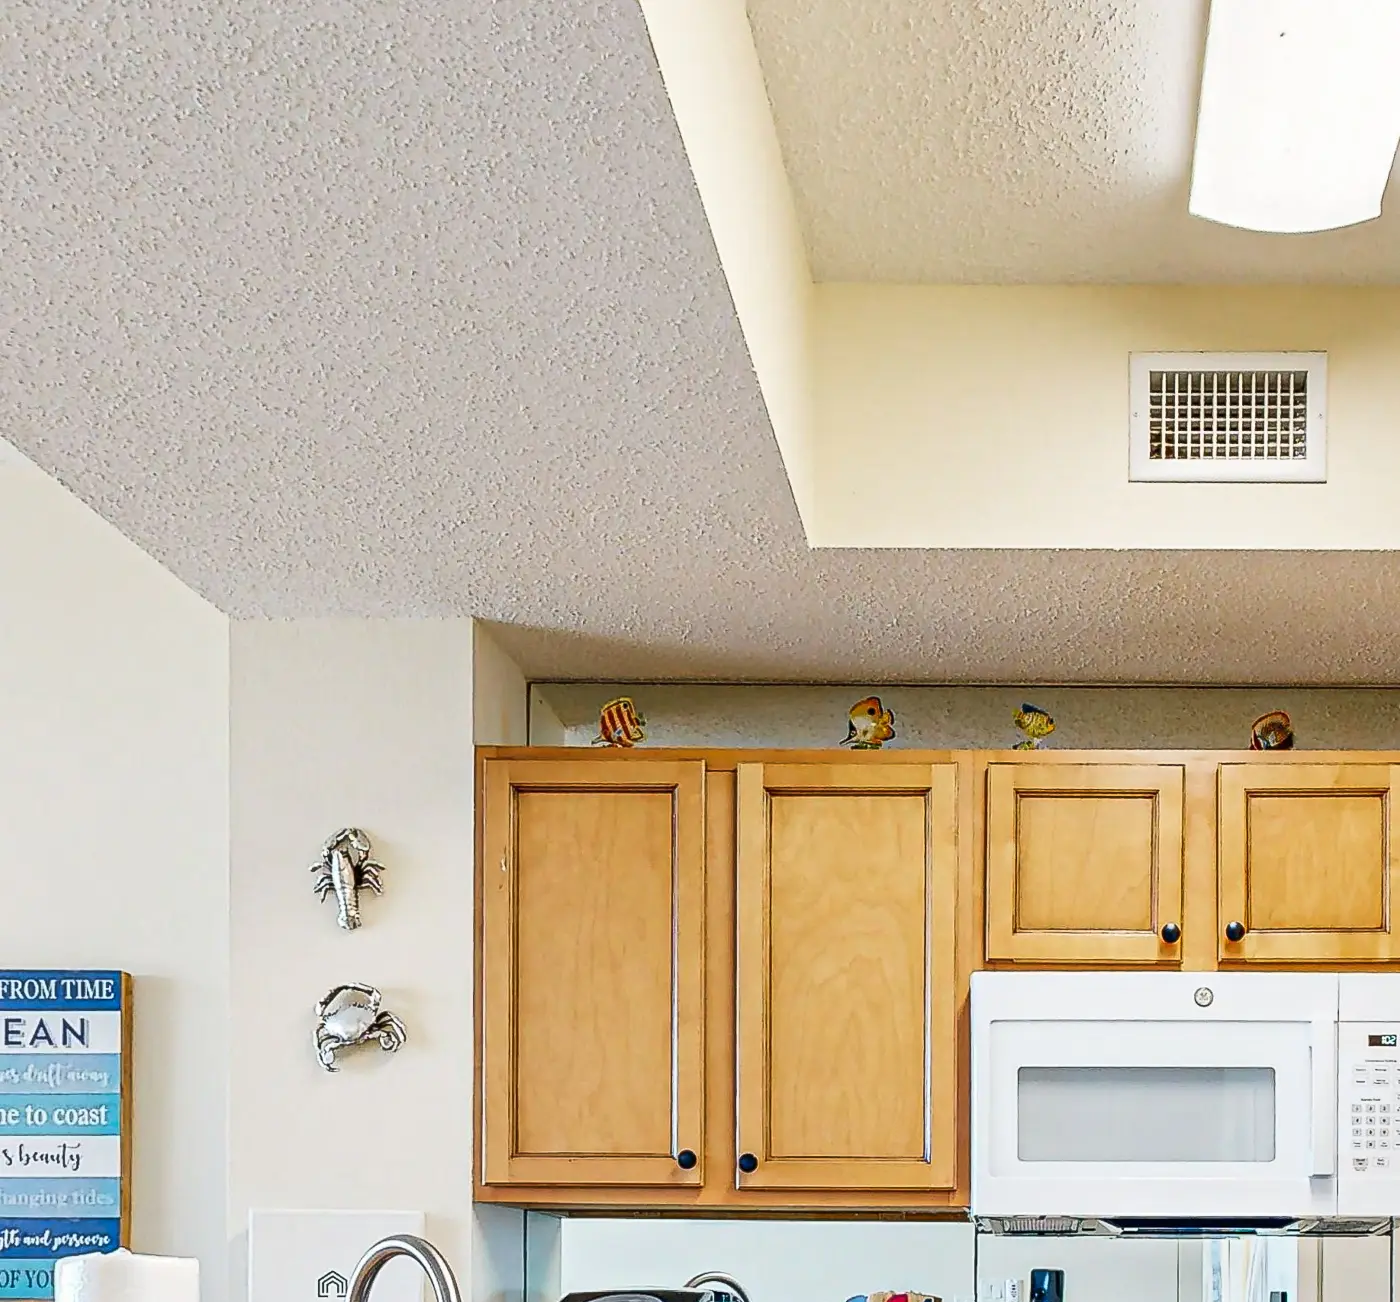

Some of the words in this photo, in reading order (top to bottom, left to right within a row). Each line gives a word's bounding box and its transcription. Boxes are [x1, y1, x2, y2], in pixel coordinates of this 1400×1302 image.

[0, 979, 57, 999] FROM
[61, 979, 115, 999] TIME
[25, 1105, 48, 1125] to
[53, 1105, 108, 1125] coast
[18, 1143, 81, 1171] beauty
[72, 1189, 114, 1205] tides
[23, 1229, 51, 1246] and
[0, 1270, 20, 1288] OF
